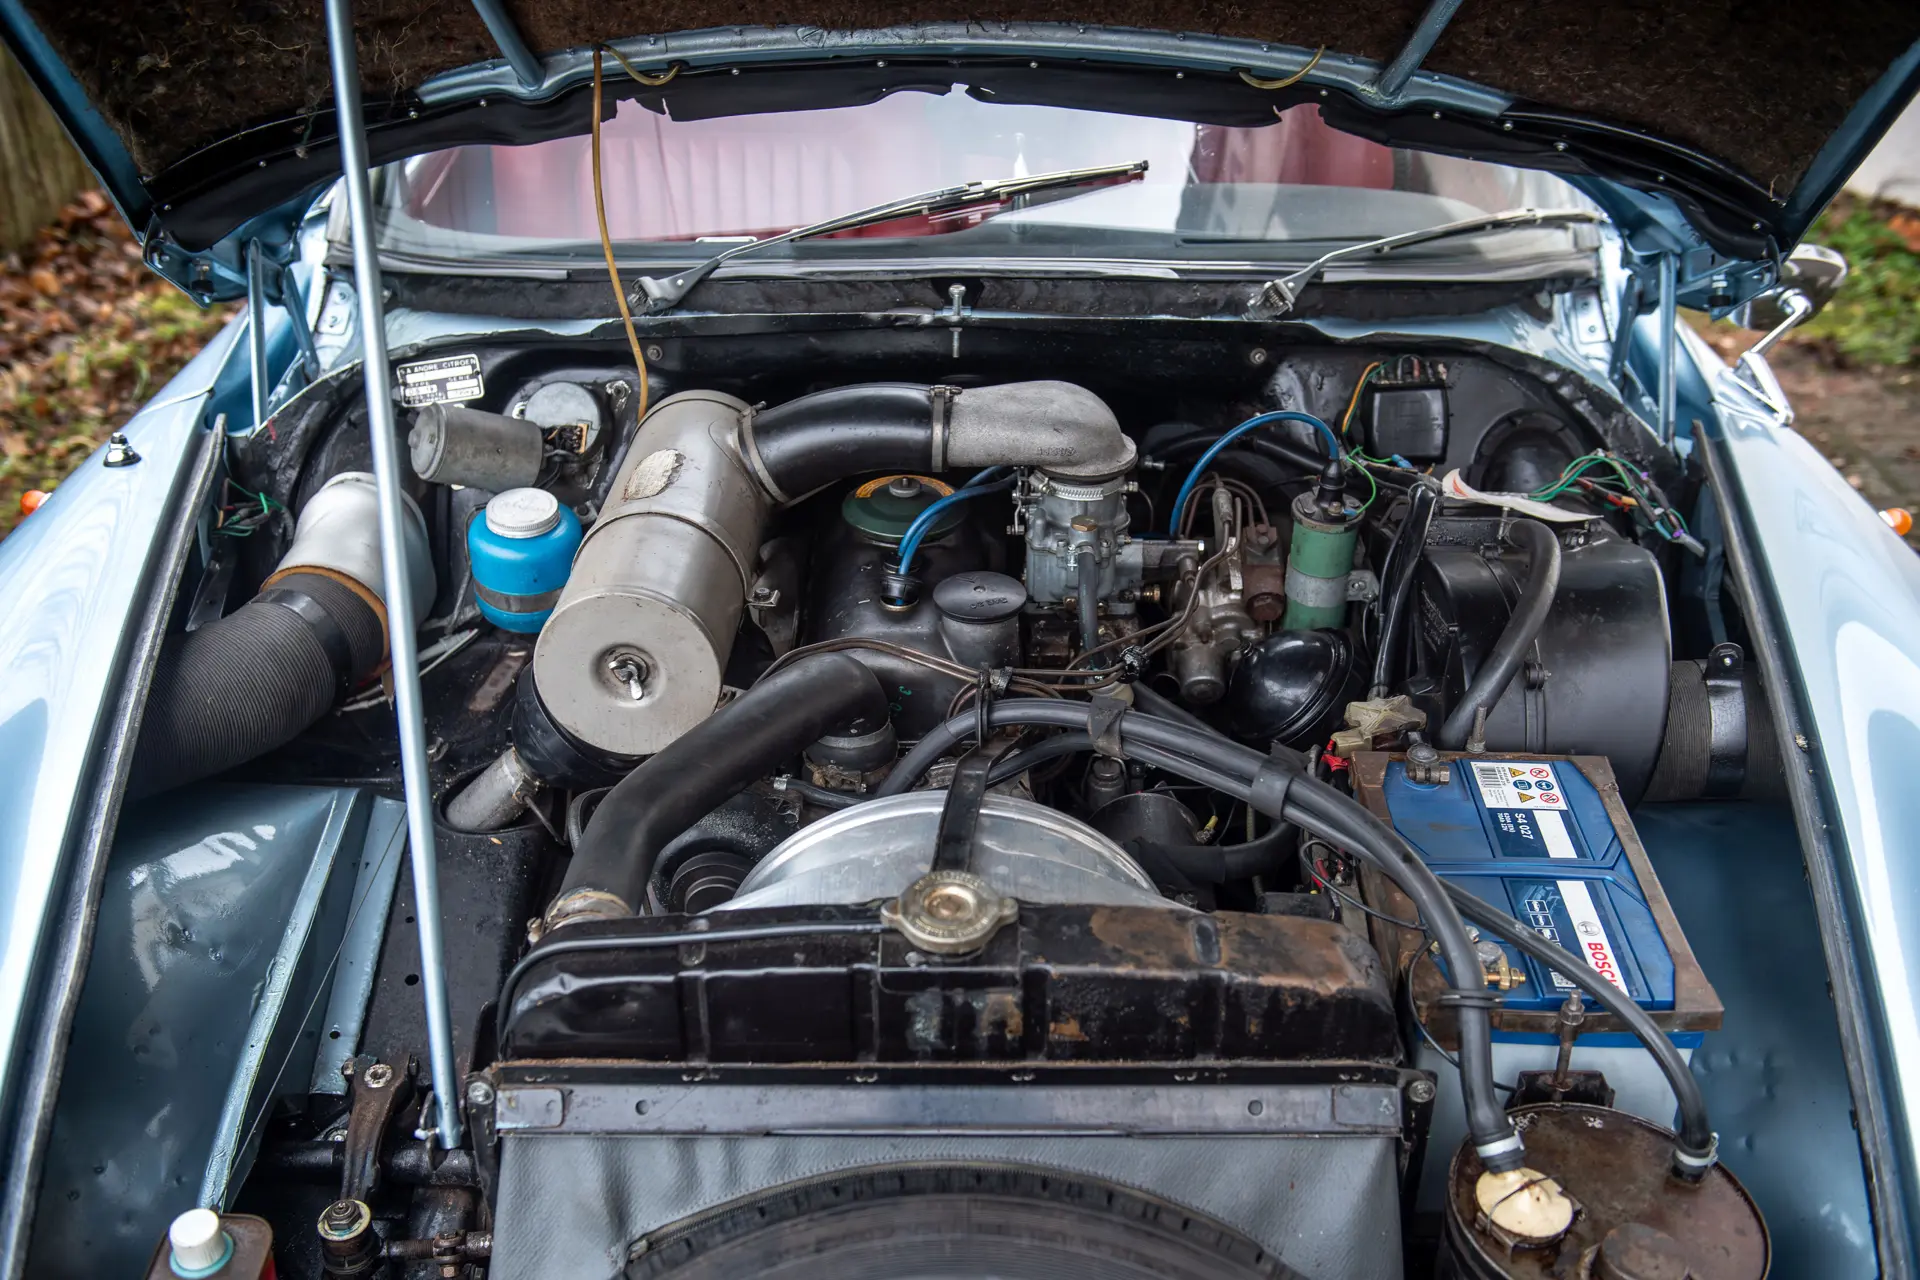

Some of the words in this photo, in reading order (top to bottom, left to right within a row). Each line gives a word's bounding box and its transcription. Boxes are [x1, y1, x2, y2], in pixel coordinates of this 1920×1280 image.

[443, 359, 476, 368] CITROEN
[1515, 813, 1527, 823] S4
[1519, 825, 1534, 839] 027
